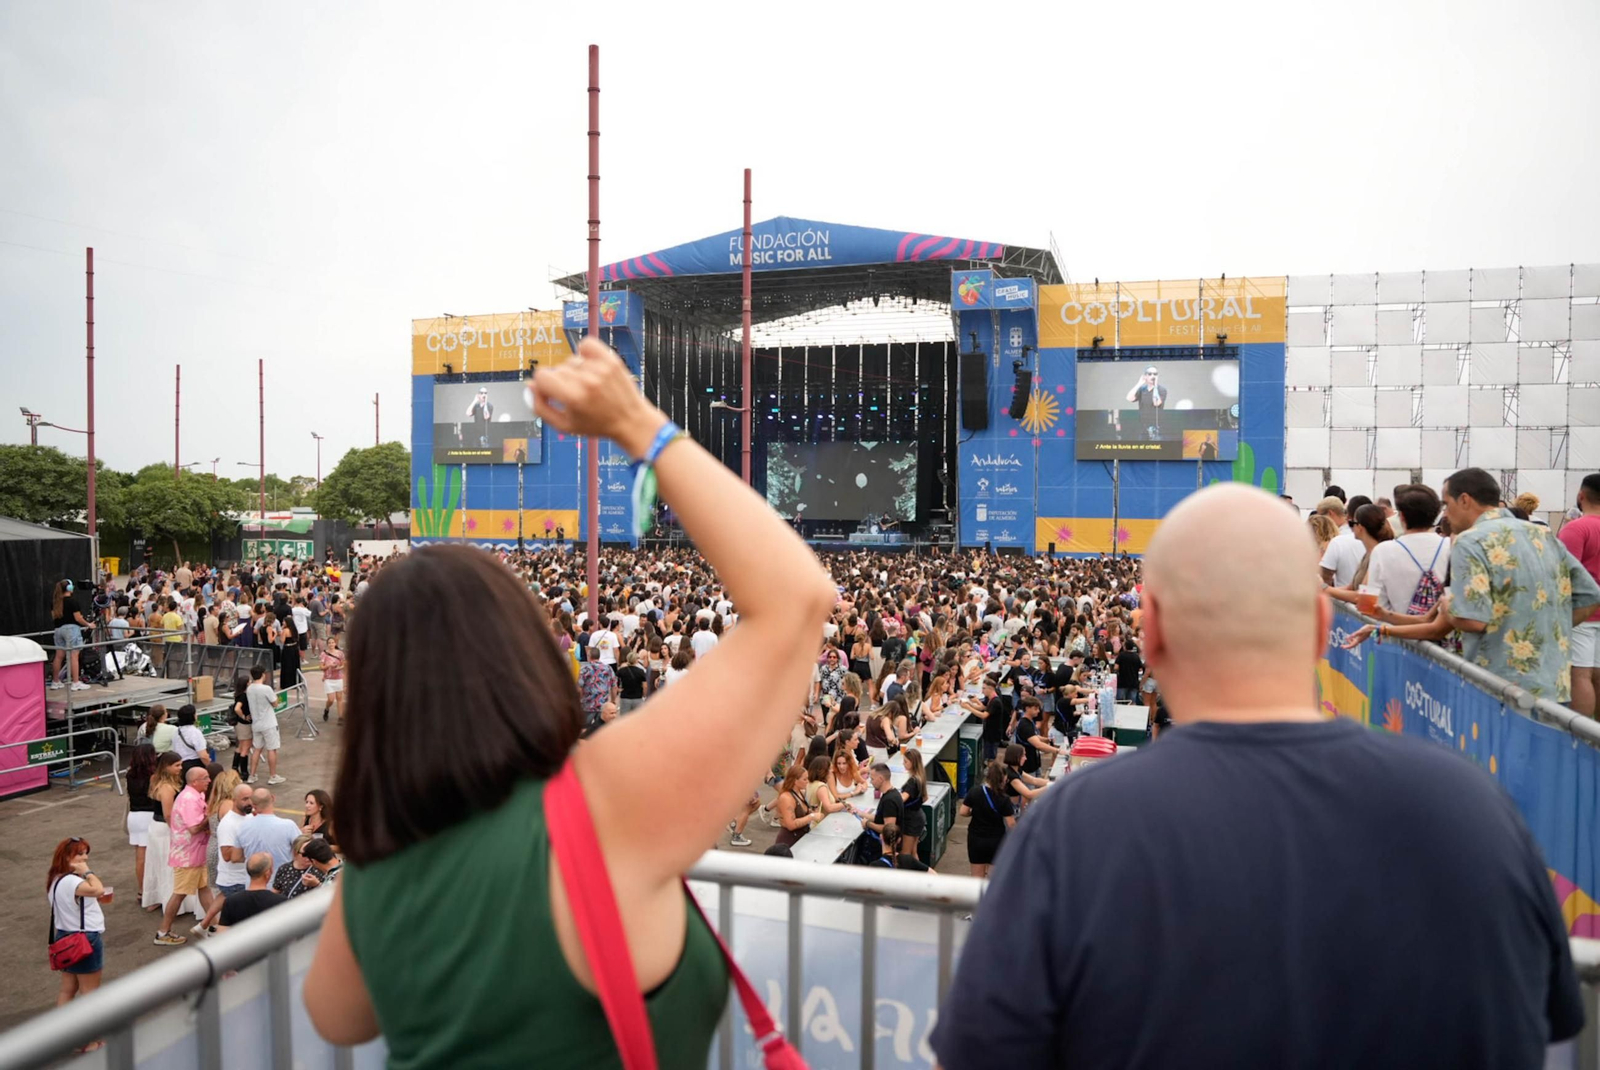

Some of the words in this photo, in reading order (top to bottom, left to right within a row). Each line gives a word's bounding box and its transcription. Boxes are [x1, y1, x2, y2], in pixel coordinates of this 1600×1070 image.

[729, 228, 829, 250] FUNDACIÓN
[729, 251, 774, 266] MSIC
[777, 249, 804, 263] FOR
[807, 247, 832, 261] ALL
[1061, 295, 1262, 325] COOLTURAL
[427, 325, 562, 352] COOLTURAL
[1170, 325, 1196, 335] FEST
[971, 453, 1022, 466] Andalucía
